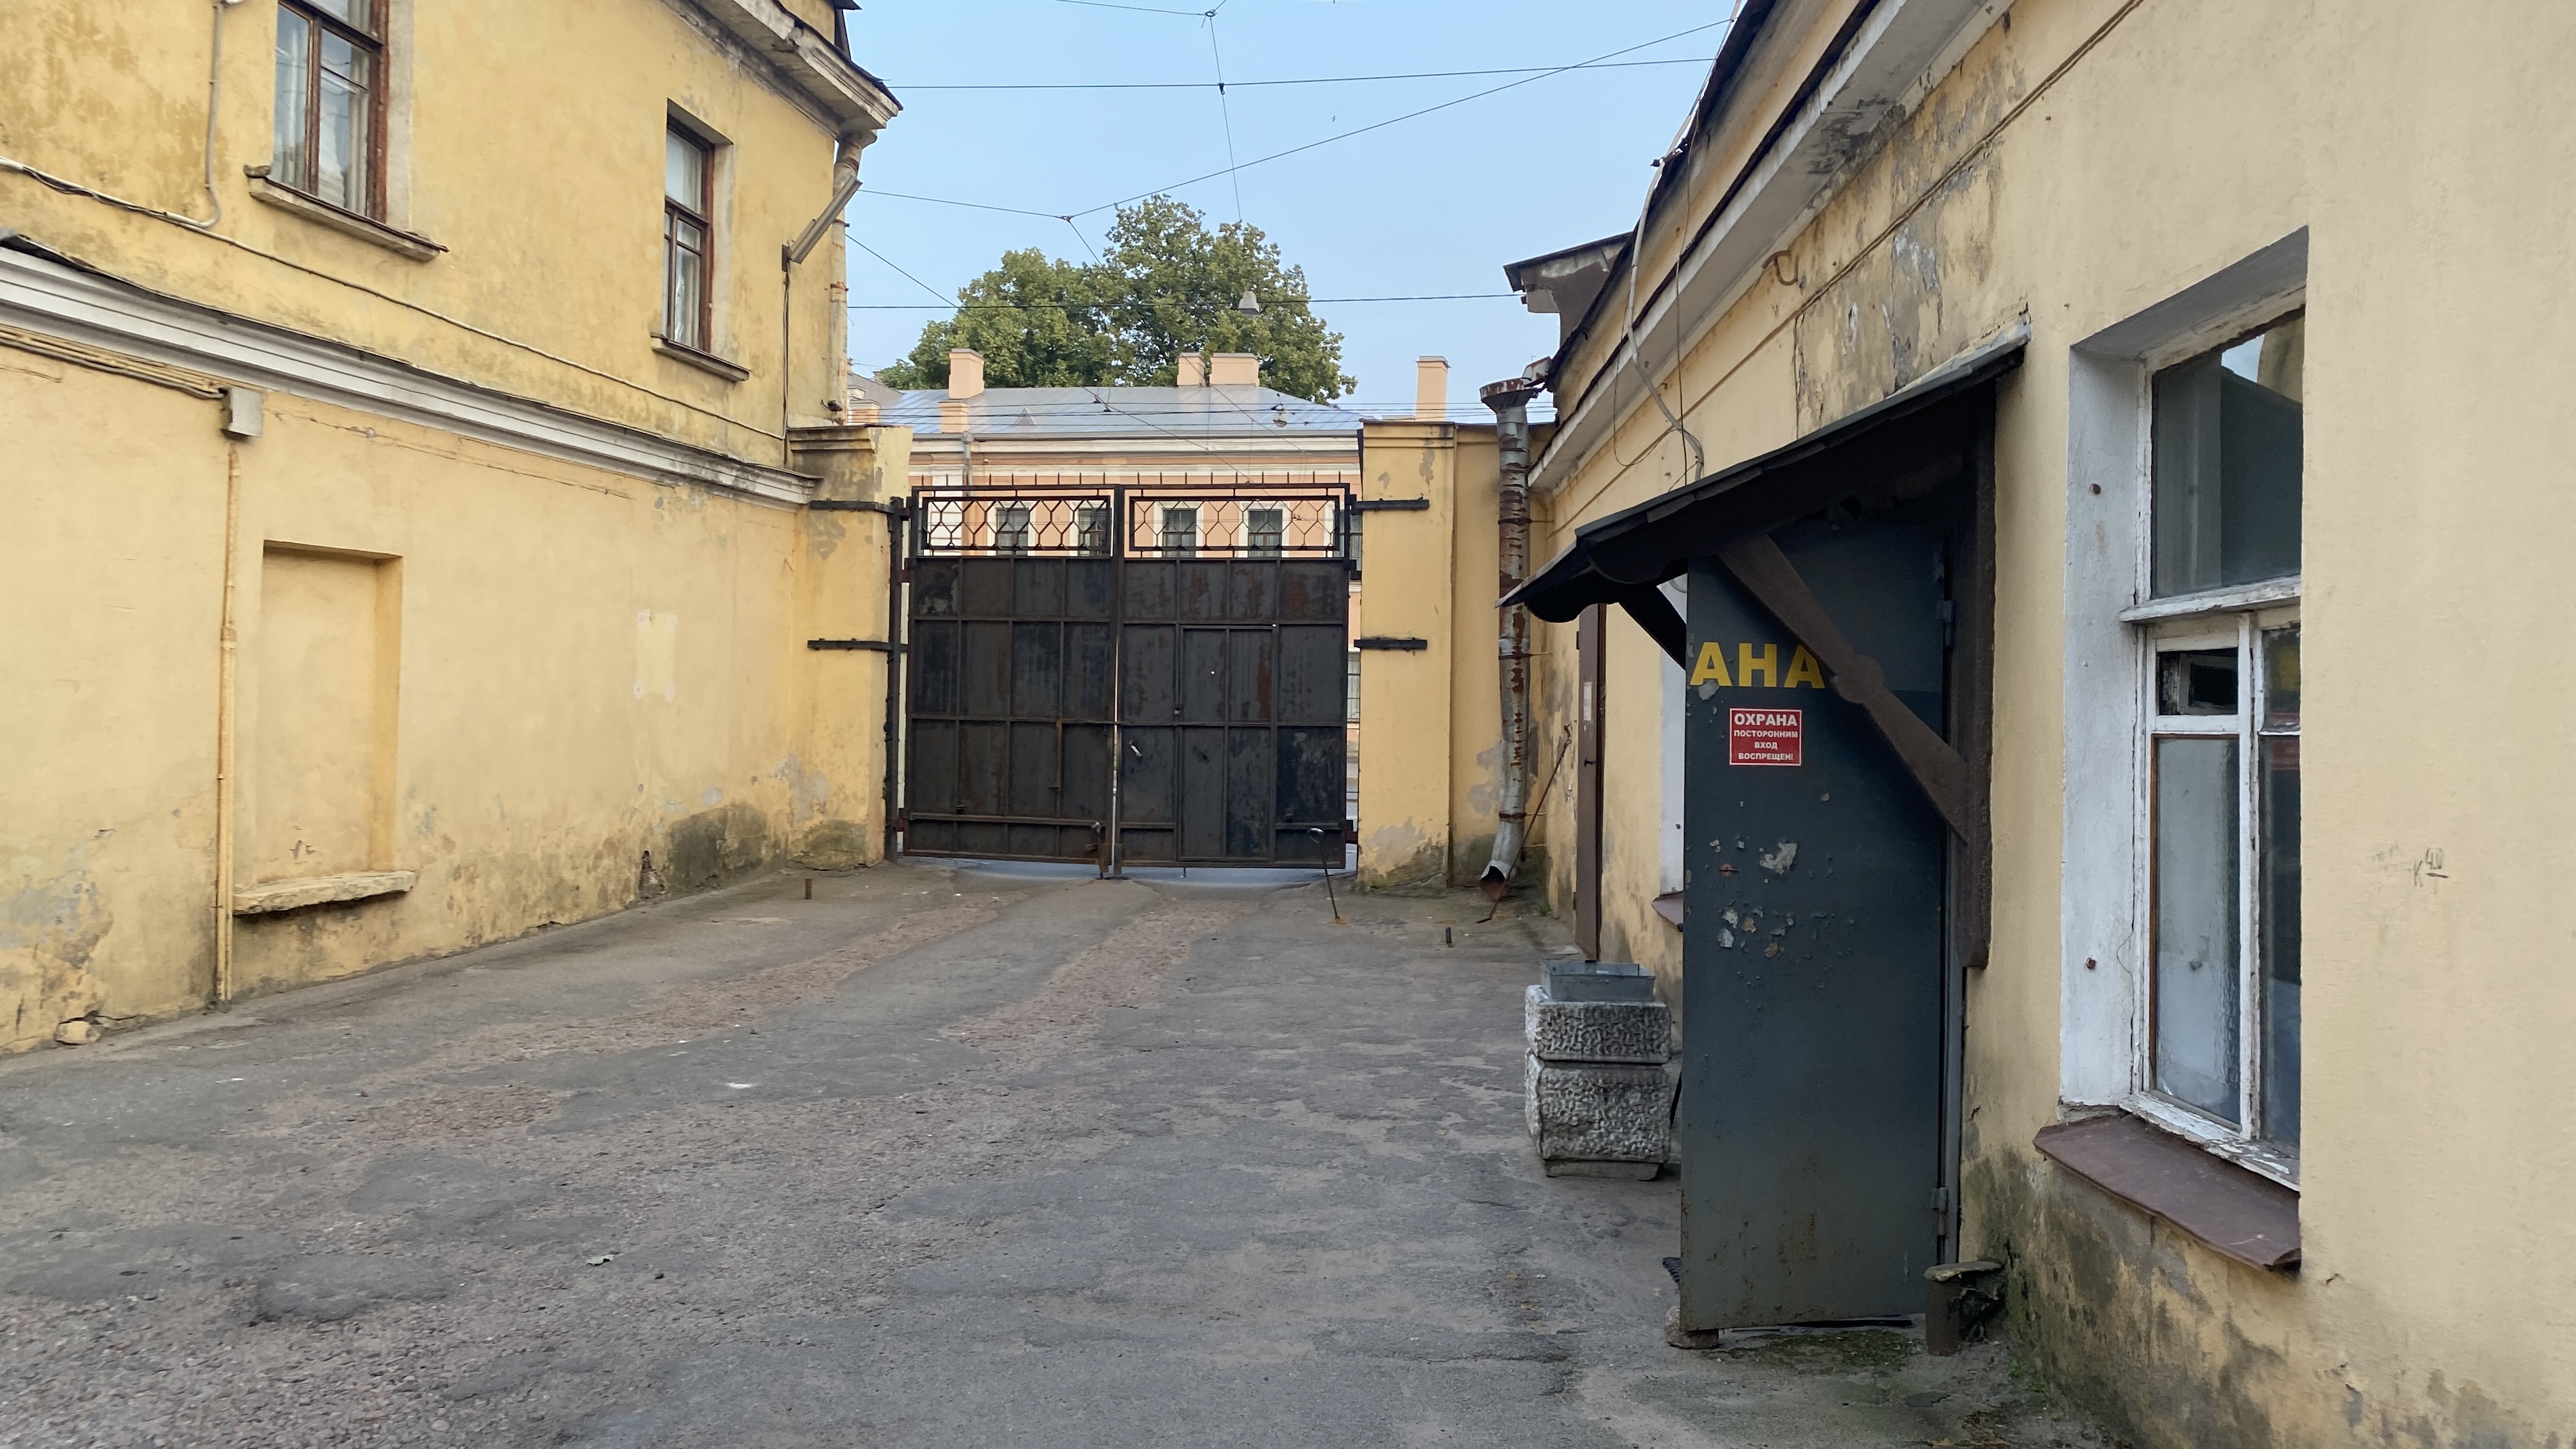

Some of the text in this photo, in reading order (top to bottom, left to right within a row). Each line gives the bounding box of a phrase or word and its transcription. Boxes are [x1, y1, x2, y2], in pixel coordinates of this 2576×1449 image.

[1689, 641, 1825, 689] АНА
[1734, 713, 1798, 726] ОХРАНА
[1733, 730, 1798, 738] ПОСТОРОННИМ
[1754, 742, 1778, 750] ВХОД
[1738, 753, 1794, 761] ВОСПРЕЩЕН!
